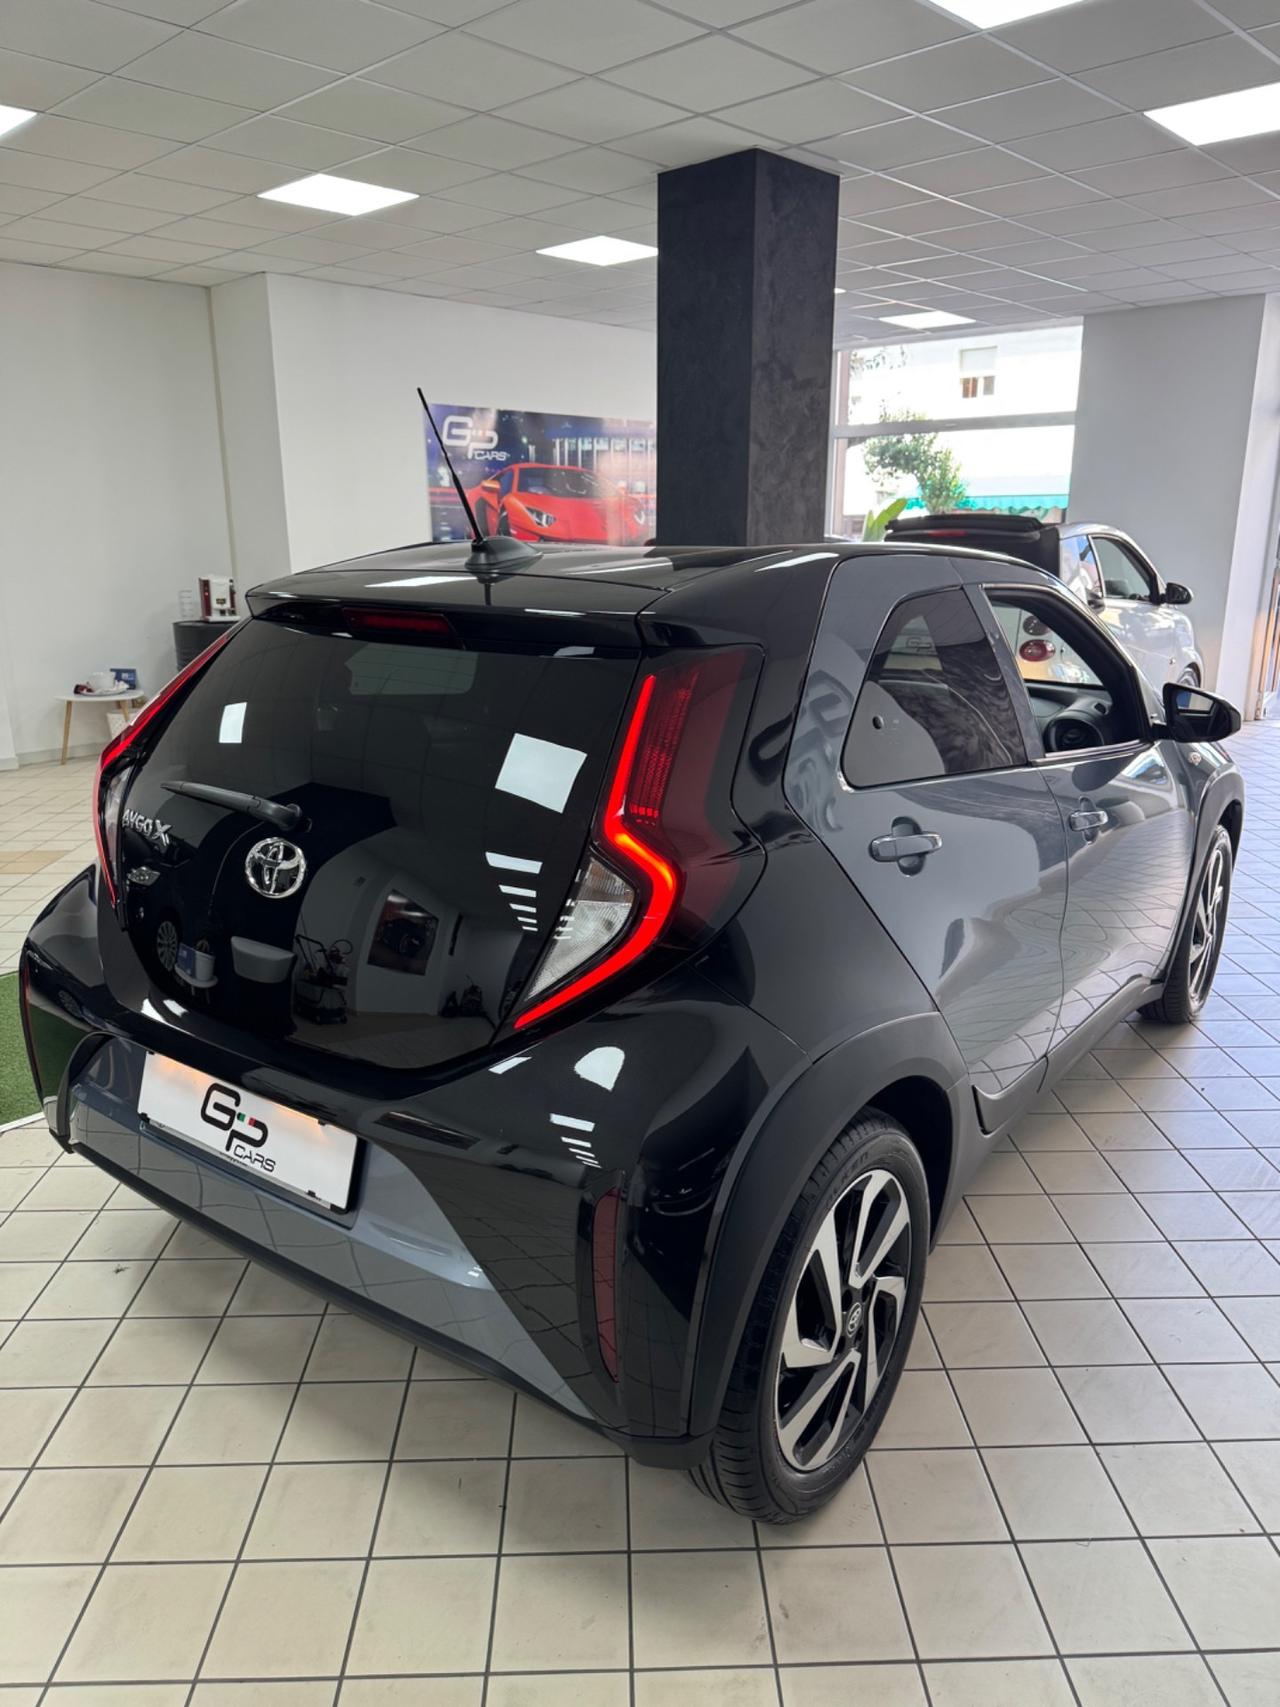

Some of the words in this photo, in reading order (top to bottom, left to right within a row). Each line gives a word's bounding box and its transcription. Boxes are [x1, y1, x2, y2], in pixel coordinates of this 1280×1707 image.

[474, 450, 507, 461] CARS
[121, 808, 153, 837] AYGO
[151, 819, 172, 847] X
[200, 1082, 269, 1152] GP
[233, 1144, 276, 1172] CARS
